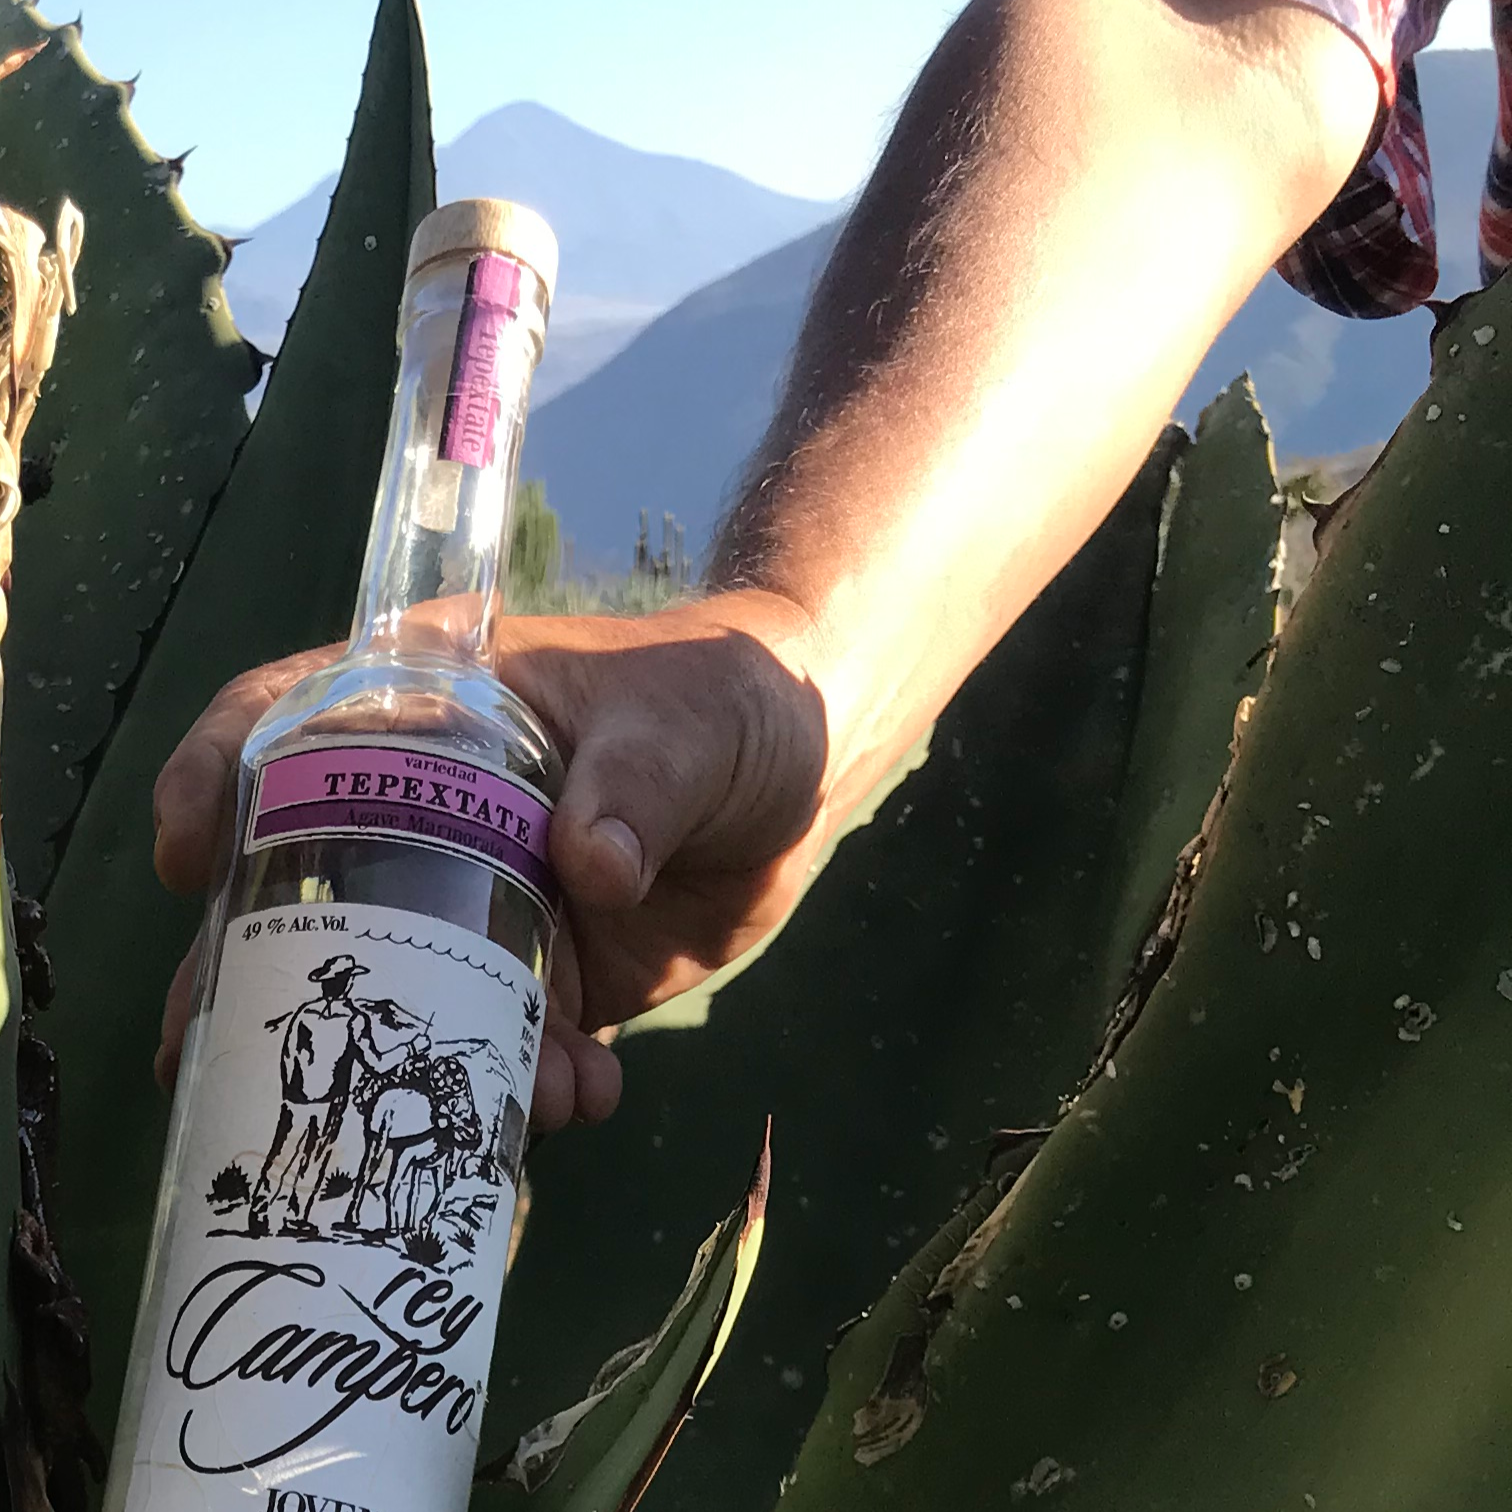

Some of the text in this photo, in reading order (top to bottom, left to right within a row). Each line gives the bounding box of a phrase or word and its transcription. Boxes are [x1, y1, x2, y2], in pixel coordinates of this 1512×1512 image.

[405, 757, 477, 784] variedad
[324, 773, 531, 845] TEPEXTATE
[344, 808, 400, 830] Agave
[242, 922, 262, 941] 49
[267, 917, 286, 936] %
[166, 1260, 476, 1474] Campero
